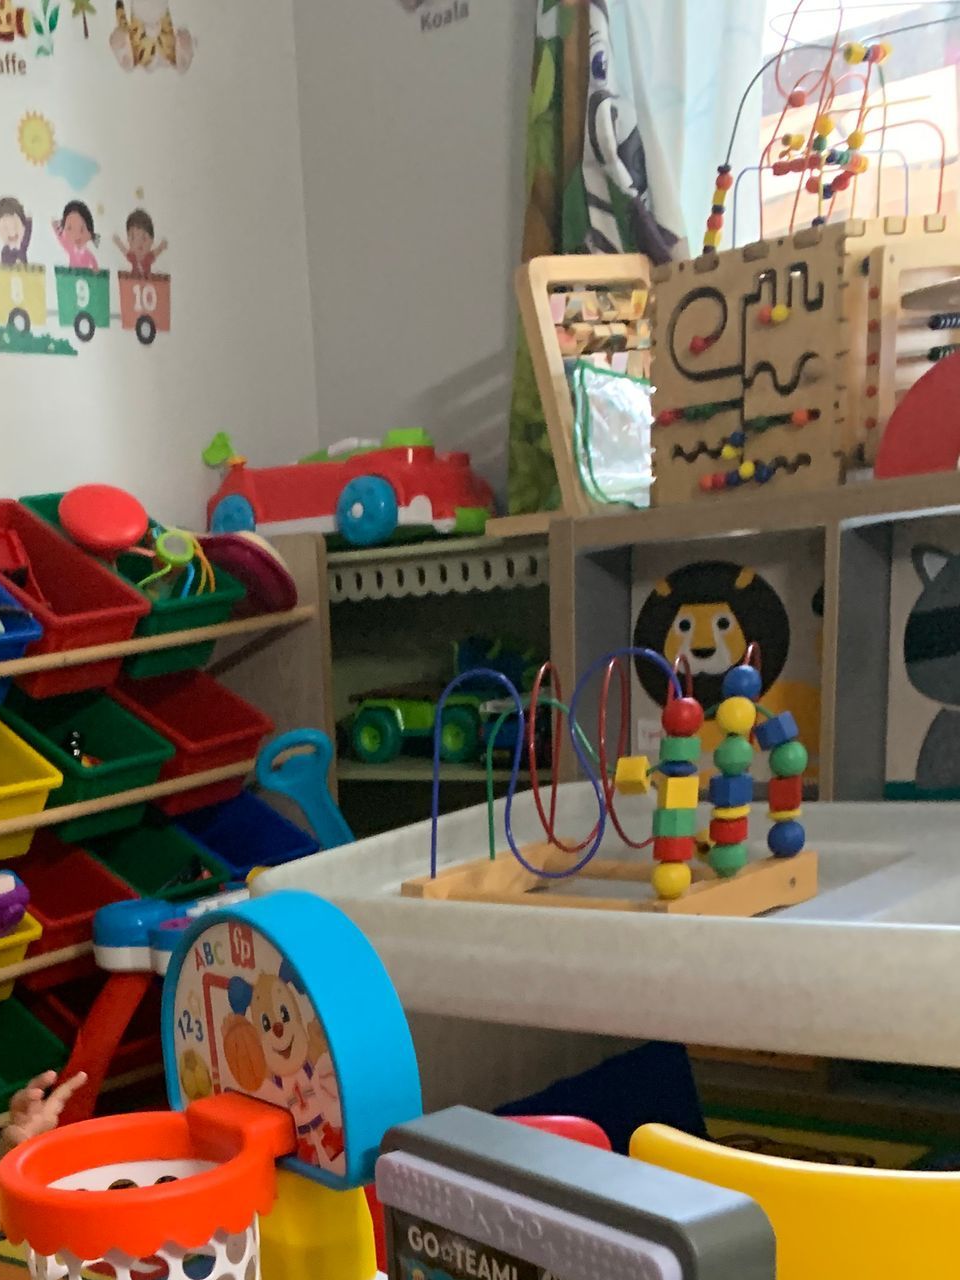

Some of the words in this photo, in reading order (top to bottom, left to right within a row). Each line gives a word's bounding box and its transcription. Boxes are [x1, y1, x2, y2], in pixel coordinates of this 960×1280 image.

[420, 0, 469, 31] Koala
[75, 278, 90, 308] 9
[132, 284, 158, 312] 10
[194, 941, 226, 971] ABC
[177, 1009, 204, 1042] 123
[407, 1225, 439, 1258] GO
